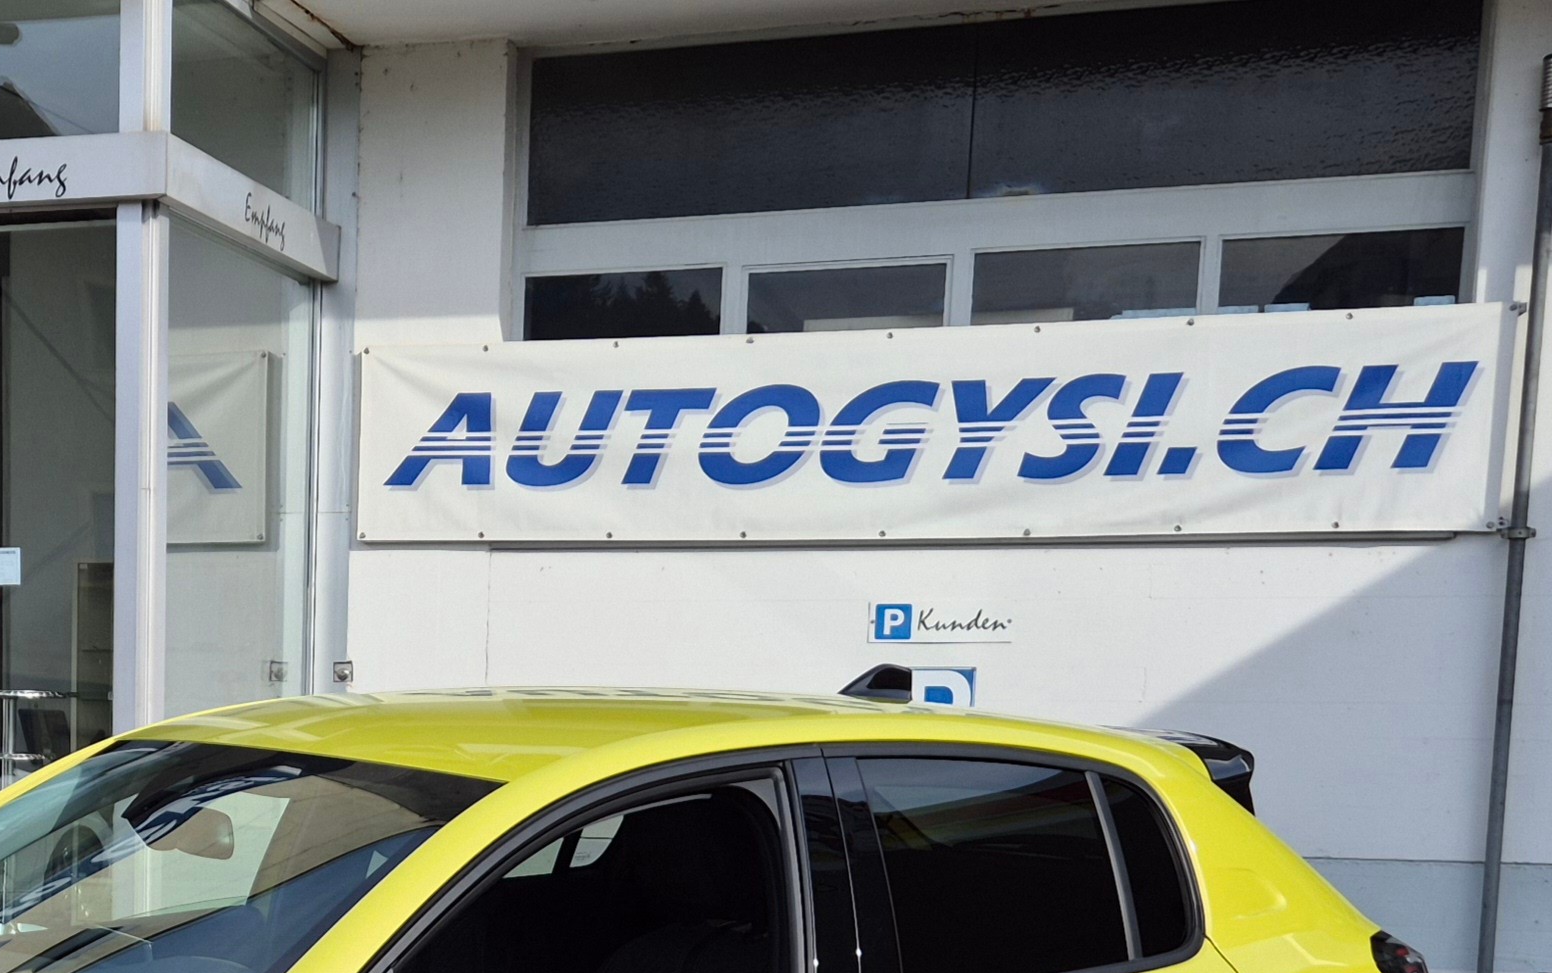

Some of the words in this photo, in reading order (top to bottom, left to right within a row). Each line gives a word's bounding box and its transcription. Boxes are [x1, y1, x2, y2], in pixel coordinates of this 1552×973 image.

[245, 192, 286, 251] Empfang
[383, 360, 1480, 490] AUTOGYSI.CH
[917, 607, 1008, 632] Kunden
